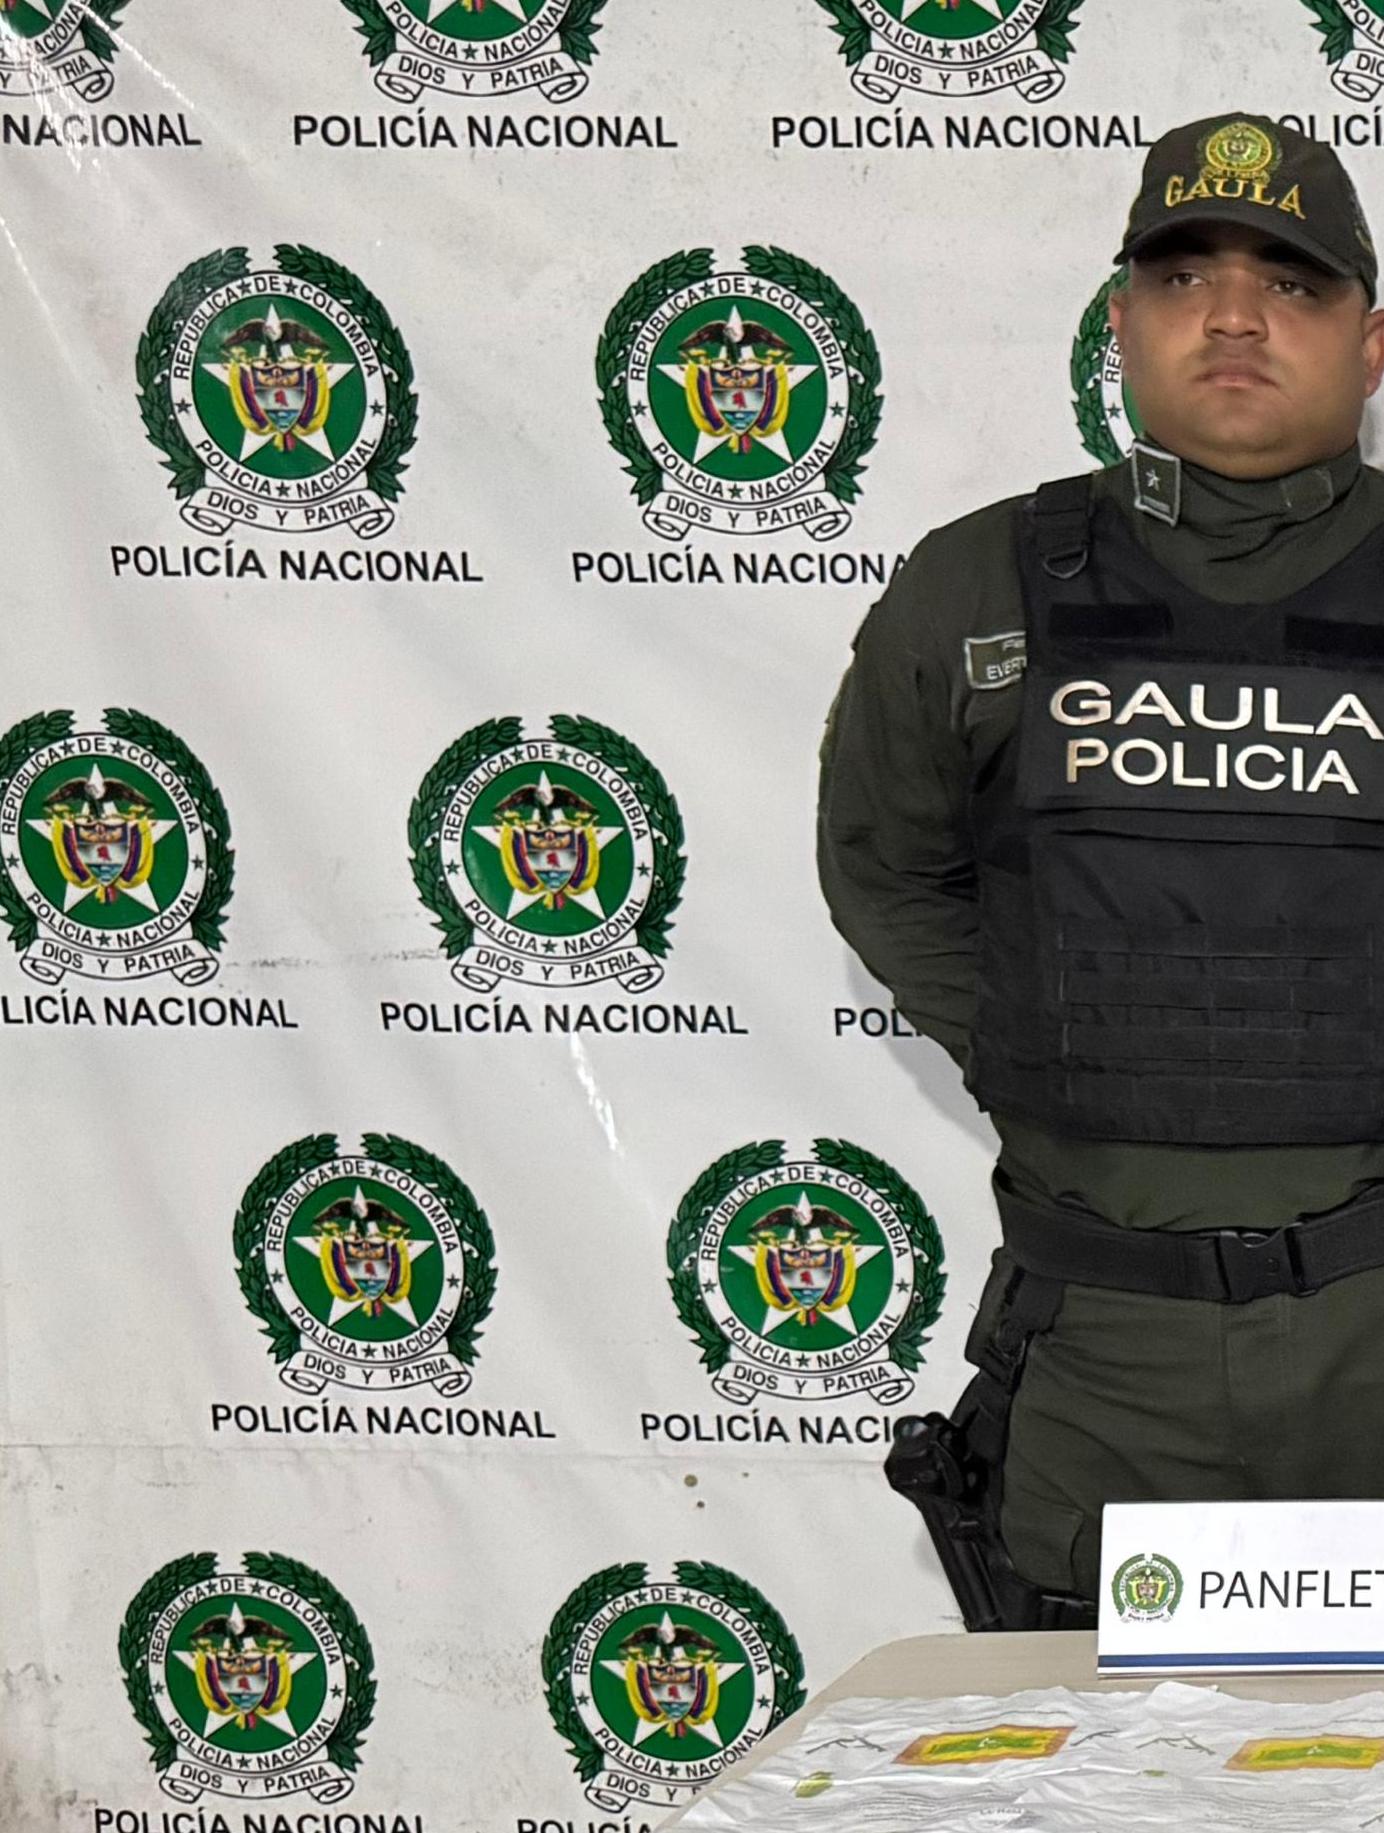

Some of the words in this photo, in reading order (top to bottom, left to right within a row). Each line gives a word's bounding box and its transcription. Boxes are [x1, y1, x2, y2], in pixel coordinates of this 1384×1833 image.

[3, 114, 202, 146] NACIONAL
[294, 107, 457, 147] POLICÍA
[467, 115, 678, 147] NACIONAL
[772, 107, 934, 148] POLICÍA
[943, 112, 1153, 150] NACIONAL
[1164, 175, 1307, 220] GAULA
[174, 284, 242, 381] REPUBLICA
[253, 275, 282, 292] DE
[299, 283, 380, 378] COLOMBIA
[630, 286, 705, 382] REPUBLICA
[716, 276, 746, 293] DE
[765, 284, 845, 379] COLOMBIA
[195, 439, 272, 496] POLICIA
[295, 439, 377, 499] NACIONAL
[651, 441, 724, 498] POLICIA
[748, 440, 836, 500] NACIONAL
[206, 490, 259, 521] DIOS
[275, 509, 289, 526] Y
[303, 494, 371, 526] PATRIA
[664, 494, 712, 523] DIOS
[727, 511, 740, 528] Y
[755, 495, 827, 527] PATRIA
[111, 546, 267, 578] POLICÍA
[280, 550, 483, 581] NACIONAL
[572, 545, 723, 583] POLICÍA
[1065, 737, 1361, 795] POLICIA
[443, 751, 515, 842] REPUBLICA
[525, 743, 553, 759] DE
[571, 751, 649, 841] COLOMBIA
[463, 898, 537, 952] POLICIA
[562, 898, 645, 955] NACIONAL
[474, 948, 524, 976] DIOS
[540, 965, 554, 981] Y
[569, 950, 640, 980] PATRIA
[104, 997, 298, 1028] NACIONAL
[381, 996, 532, 1032] POLICÍA
[545, 1004, 748, 1034] NACIONAL
[701, 1173, 775, 1262] REPUBLICA
[786, 1165, 815, 1180] DE
[834, 1173, 910, 1258] COLOMBIA
[719, 1315, 791, 1367] POLICIA
[815, 1314, 901, 1369] NACIONAL
[732, 1364, 779, 1390] DIOS
[794, 1378, 807, 1394] Y
[822, 1364, 891, 1393] PATRIA
[212, 1398, 357, 1433] POLICÍA
[367, 1406, 556, 1438] NACIONAL
[641, 1408, 790, 1442] POLICÍA
[150, 1584, 210, 1665] REPUBLICA
[219, 1577, 246, 1592] DE
[265, 1584, 341, 1666] COLOMBIA
[168, 1717, 233, 1767] POLICIA
[255, 1717, 336, 1770] NACIONAL
[178, 1763, 223, 1789] DIOS
[236, 1778, 250, 1793] Y
[262, 1765, 331, 1793] PATRIA
